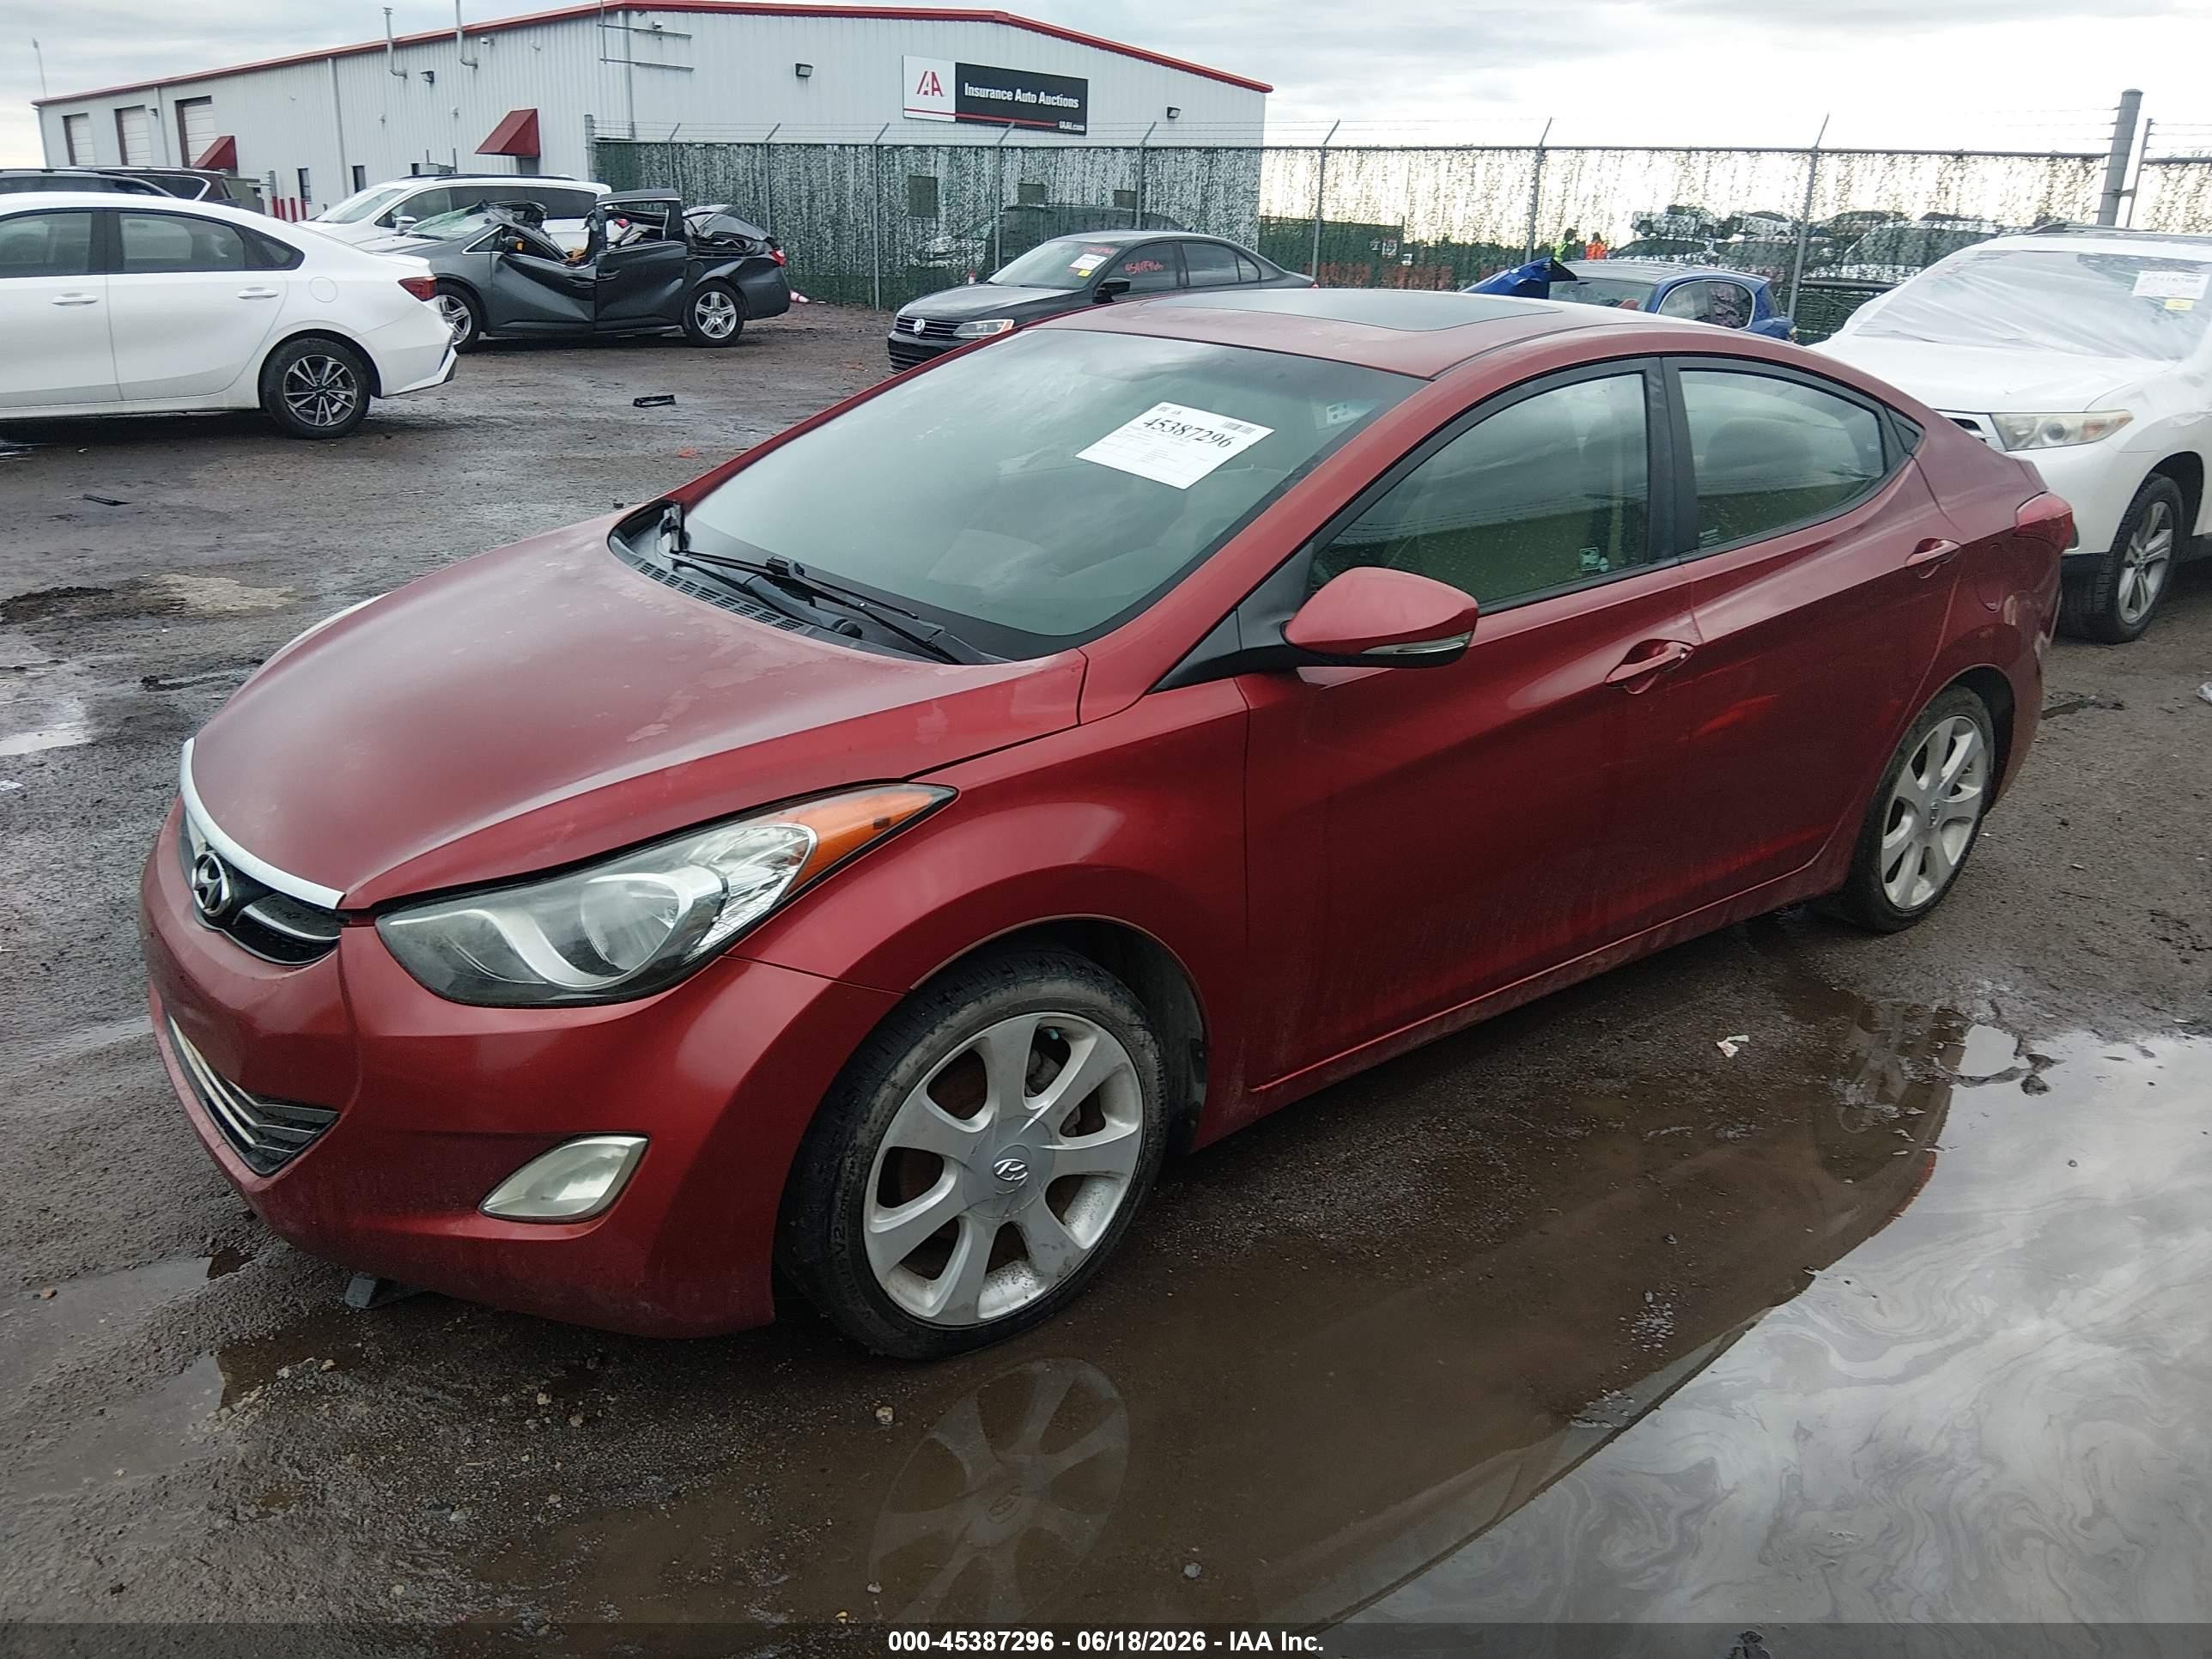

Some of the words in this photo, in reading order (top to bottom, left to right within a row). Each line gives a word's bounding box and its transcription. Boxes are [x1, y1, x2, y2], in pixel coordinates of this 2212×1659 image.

[964, 82, 1012, 100] Insurance
[1014, 89, 1036, 104] Auto
[1038, 93, 1079, 108] Auctions
[1143, 417, 1237, 448] 45387296
